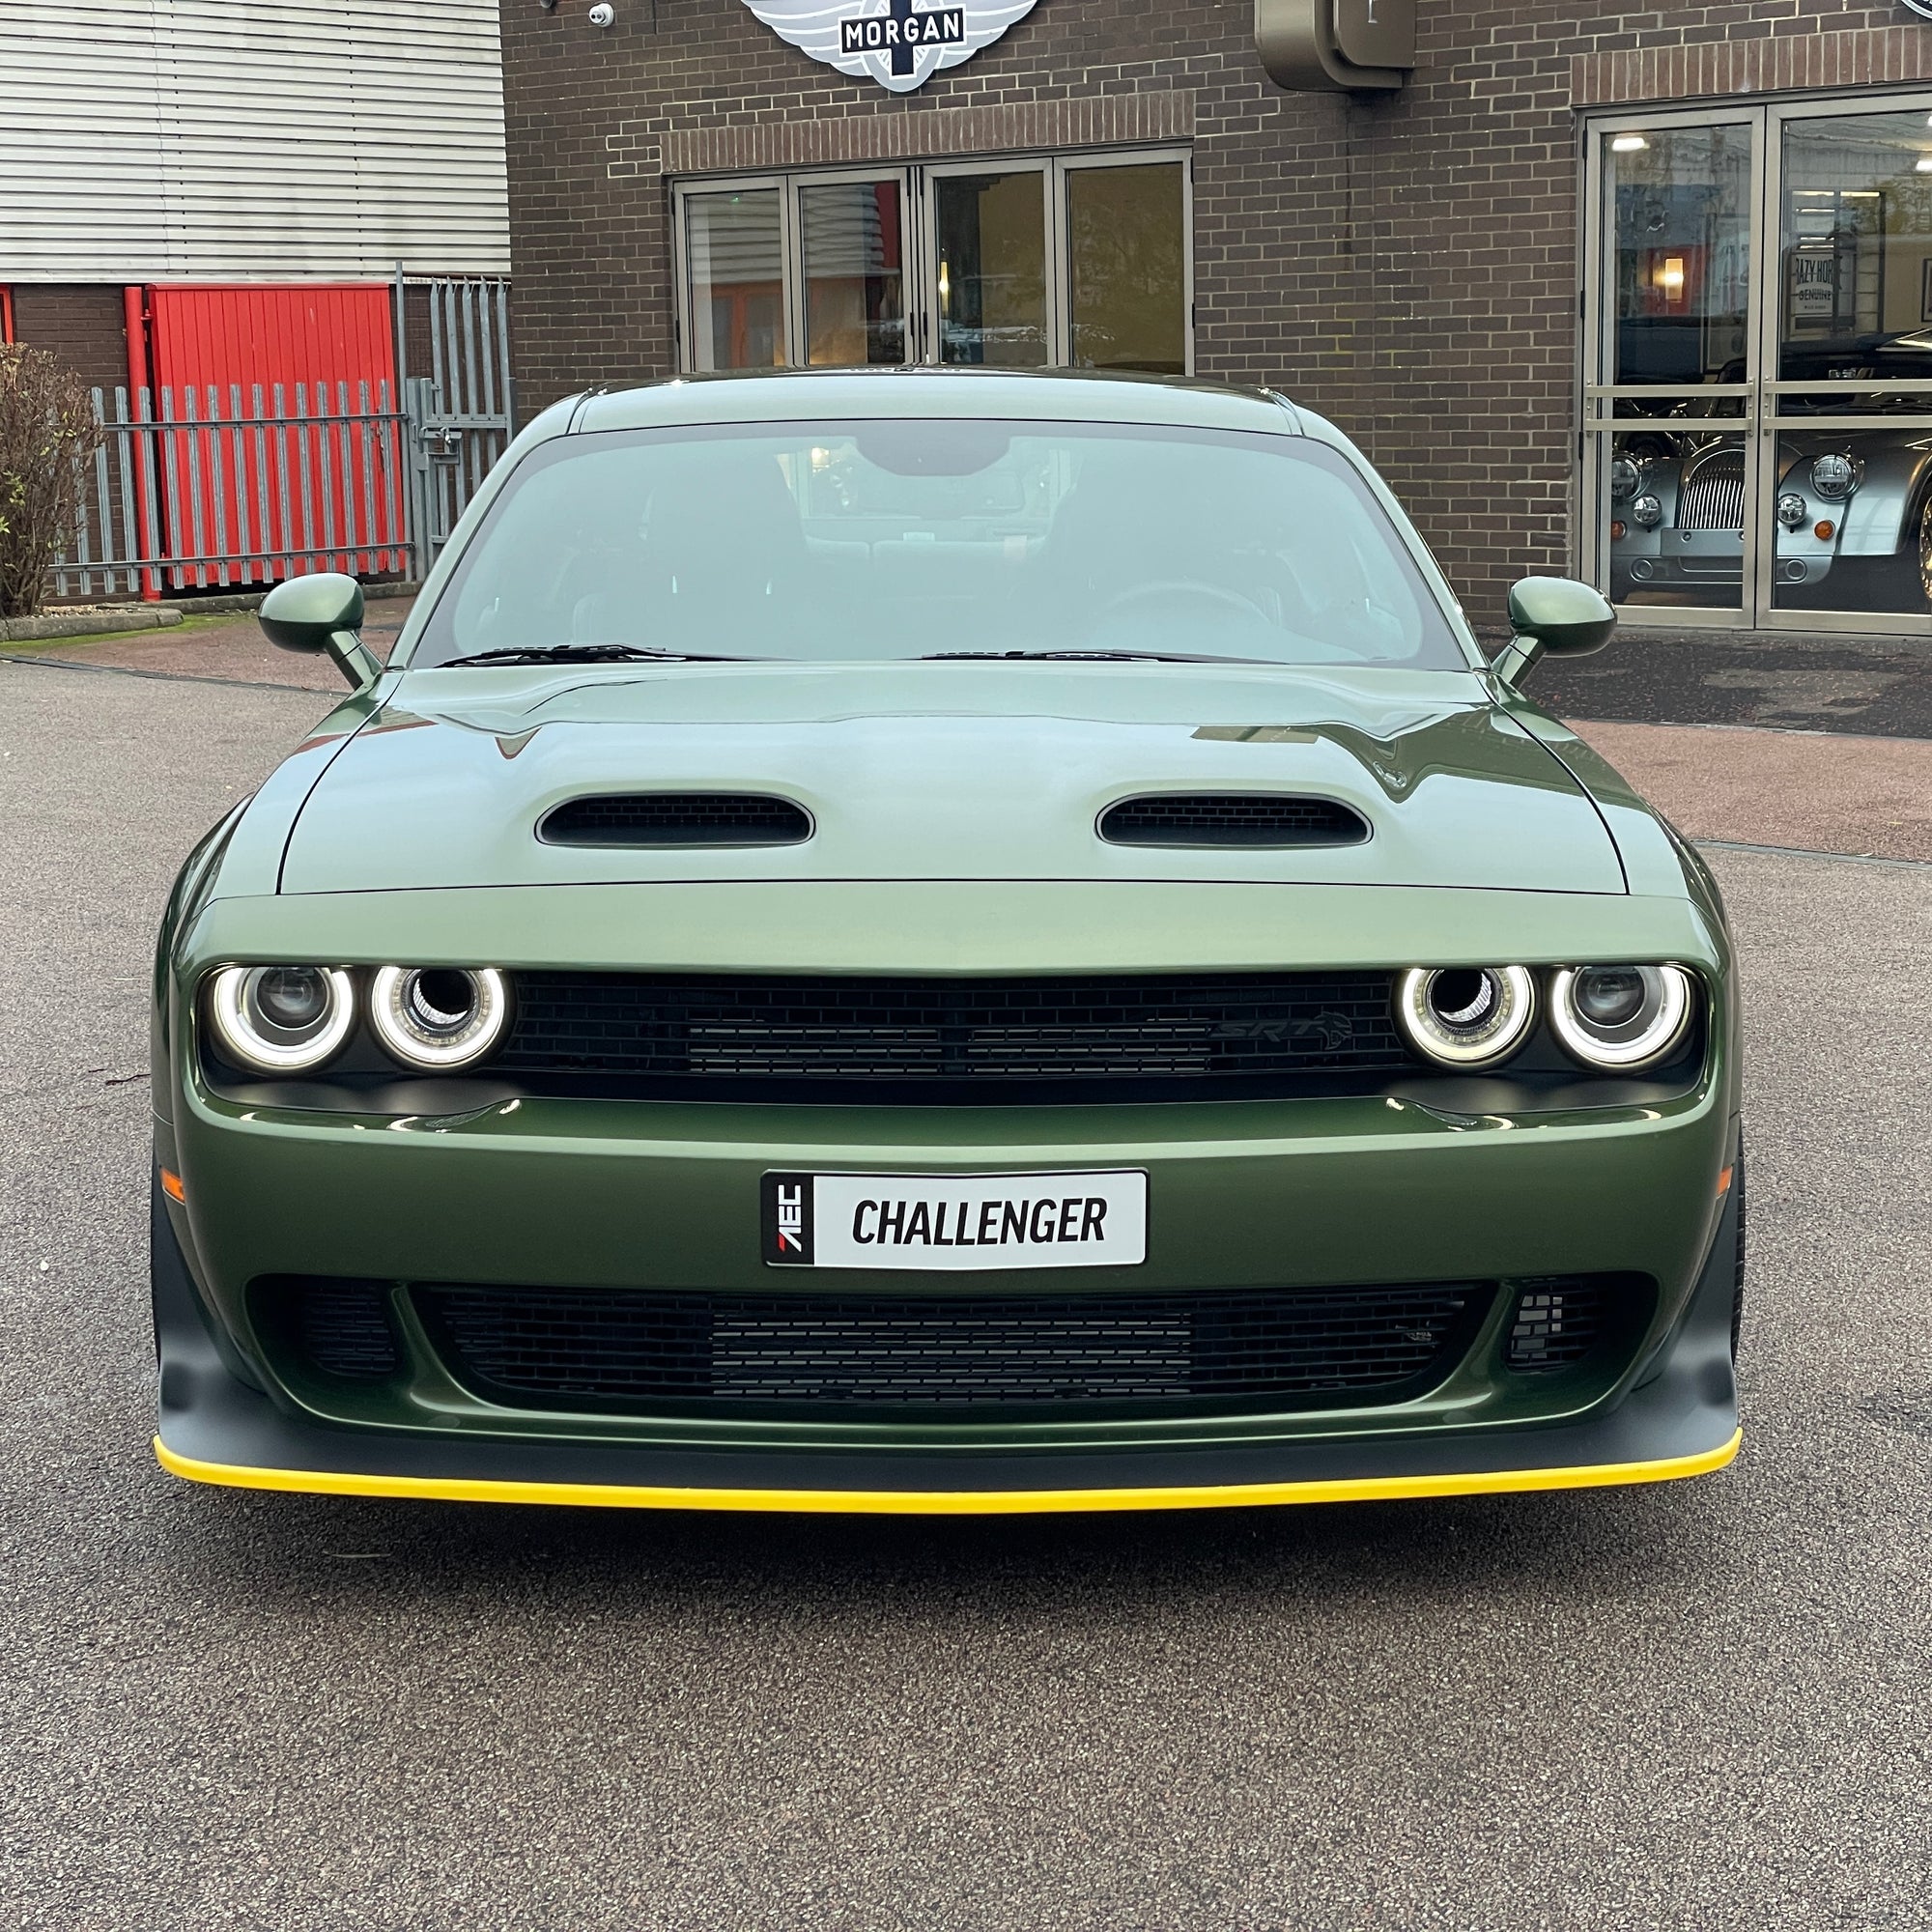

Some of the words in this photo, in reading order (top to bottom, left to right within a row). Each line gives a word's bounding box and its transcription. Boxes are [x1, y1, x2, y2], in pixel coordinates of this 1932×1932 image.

[846, 13, 959, 48] MORGAN
[1210, 1021, 1325, 1042] SRT
[779, 1184, 802, 1253] AEC
[852, 1198, 1108, 1246] CHALLENGER
